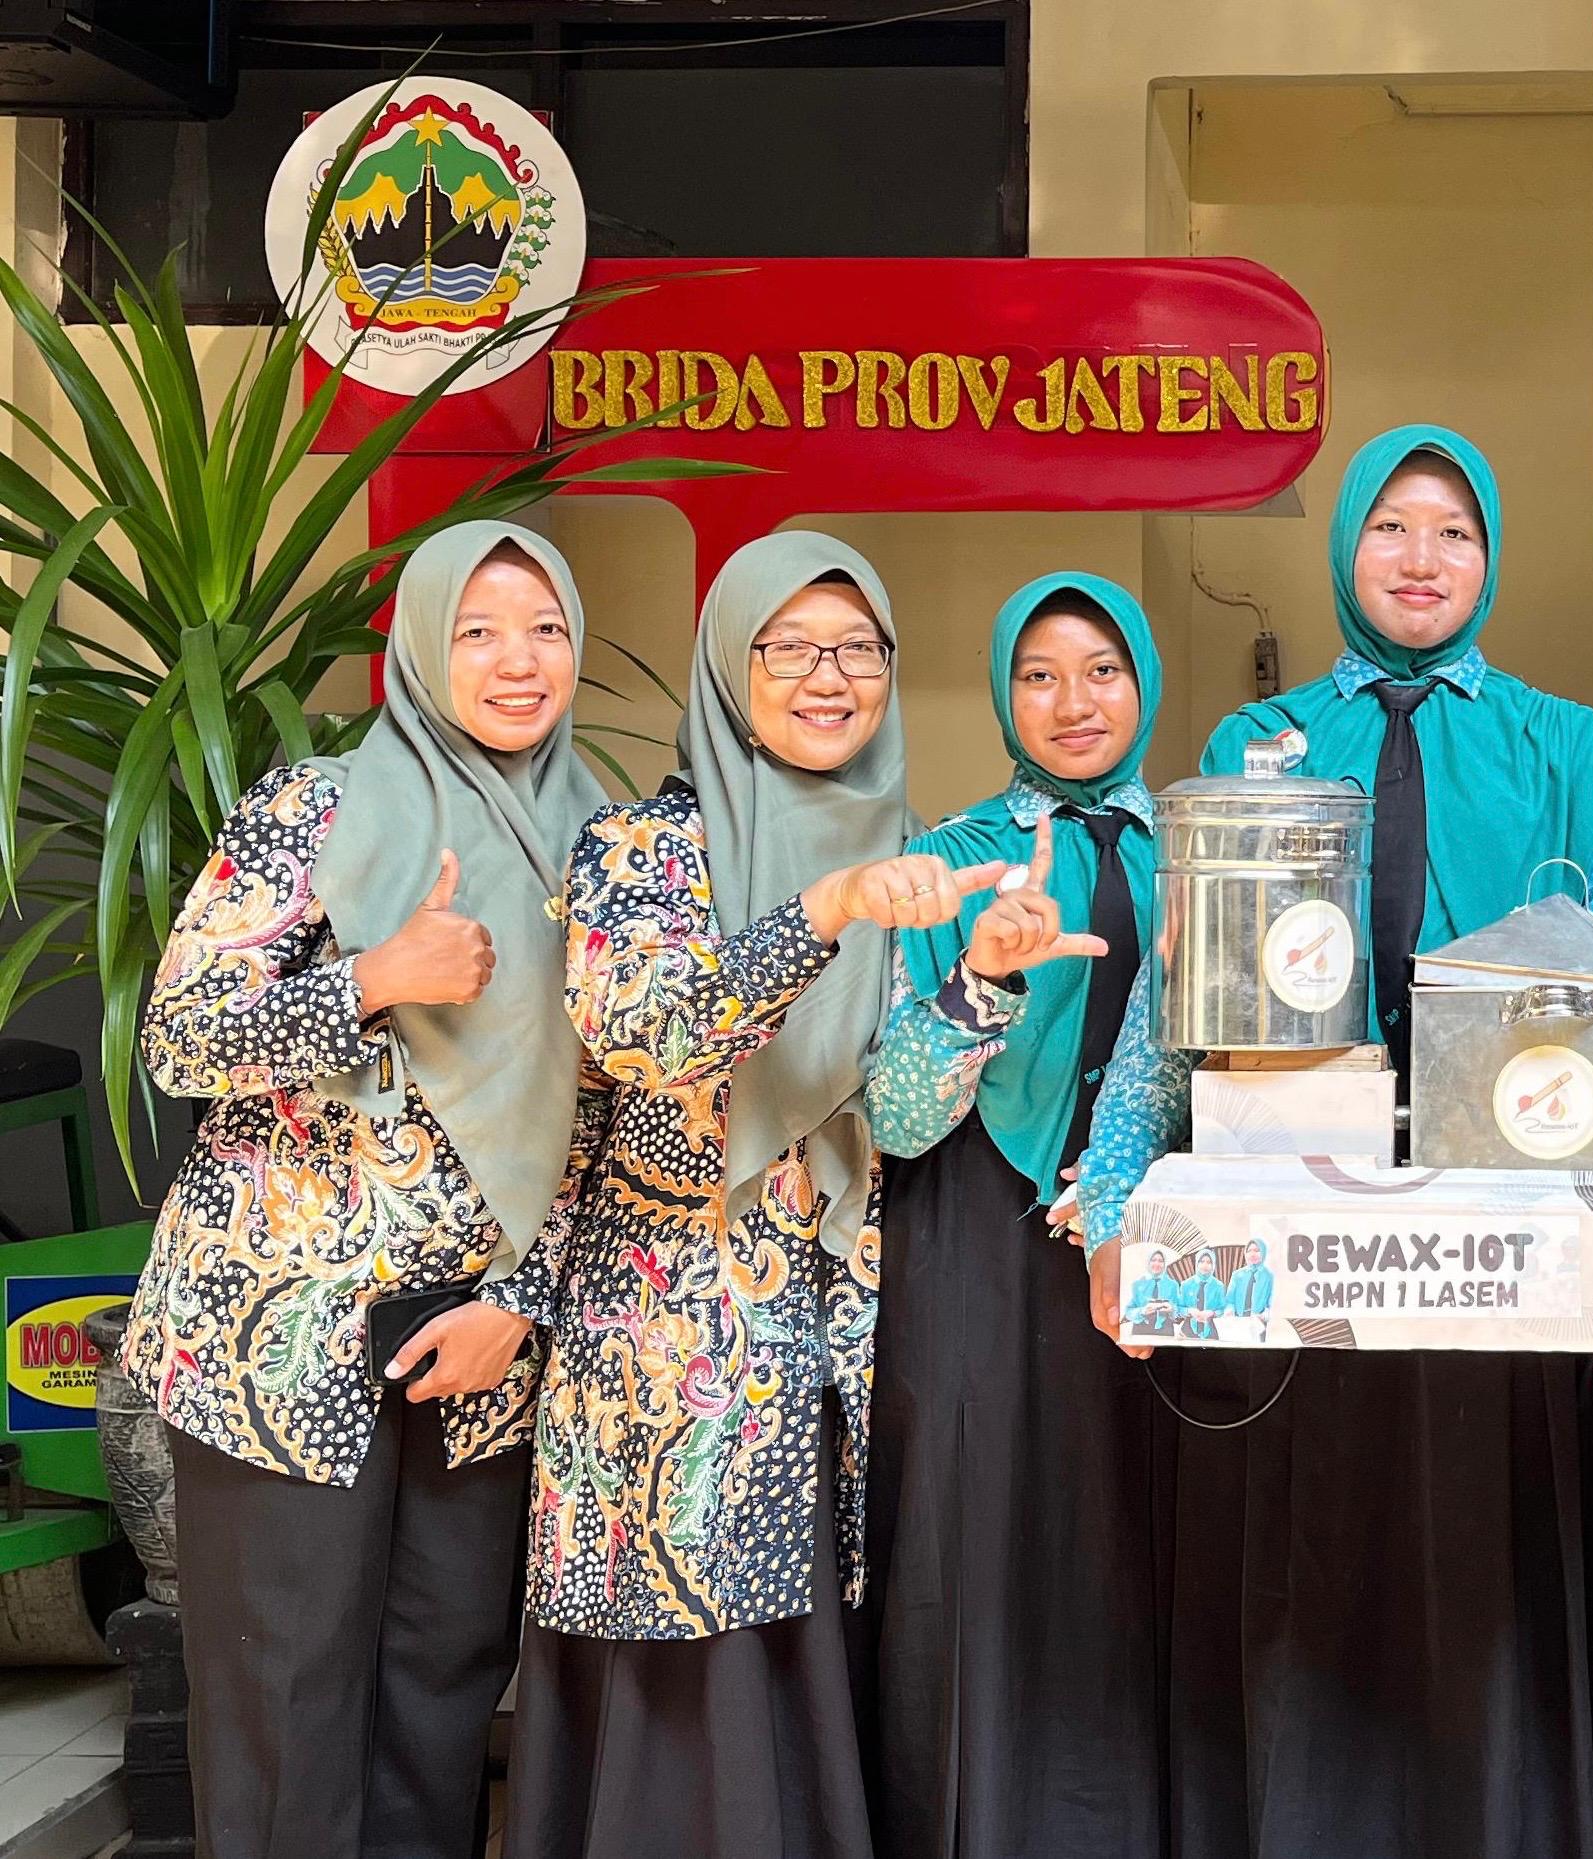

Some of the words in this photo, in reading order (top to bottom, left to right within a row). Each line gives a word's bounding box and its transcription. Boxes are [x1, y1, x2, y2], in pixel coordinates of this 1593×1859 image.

[381, 307, 414, 318] JAWA
[424, 307, 477, 318] TENGAH
[351, 332, 392, 348] ASETYA
[393, 335, 416, 349] ULAH
[418, 332, 442, 346] SAKTI
[443, 333, 474, 349] BHAKTI
[549, 350, 791, 431] BRIDA
[798, 350, 1010, 432] PROV
[1013, 351, 1318, 434] JATENG
[1287, 1233, 1534, 1273] REWAX-IOT
[1304, 1281, 1386, 1309] SMPN
[1397, 1280, 1407, 1308] 1
[1418, 1280, 1519, 1308] LASEM
[49, 1370, 98, 1379] MESIN
[41, 1380, 97, 1389] GARAM
